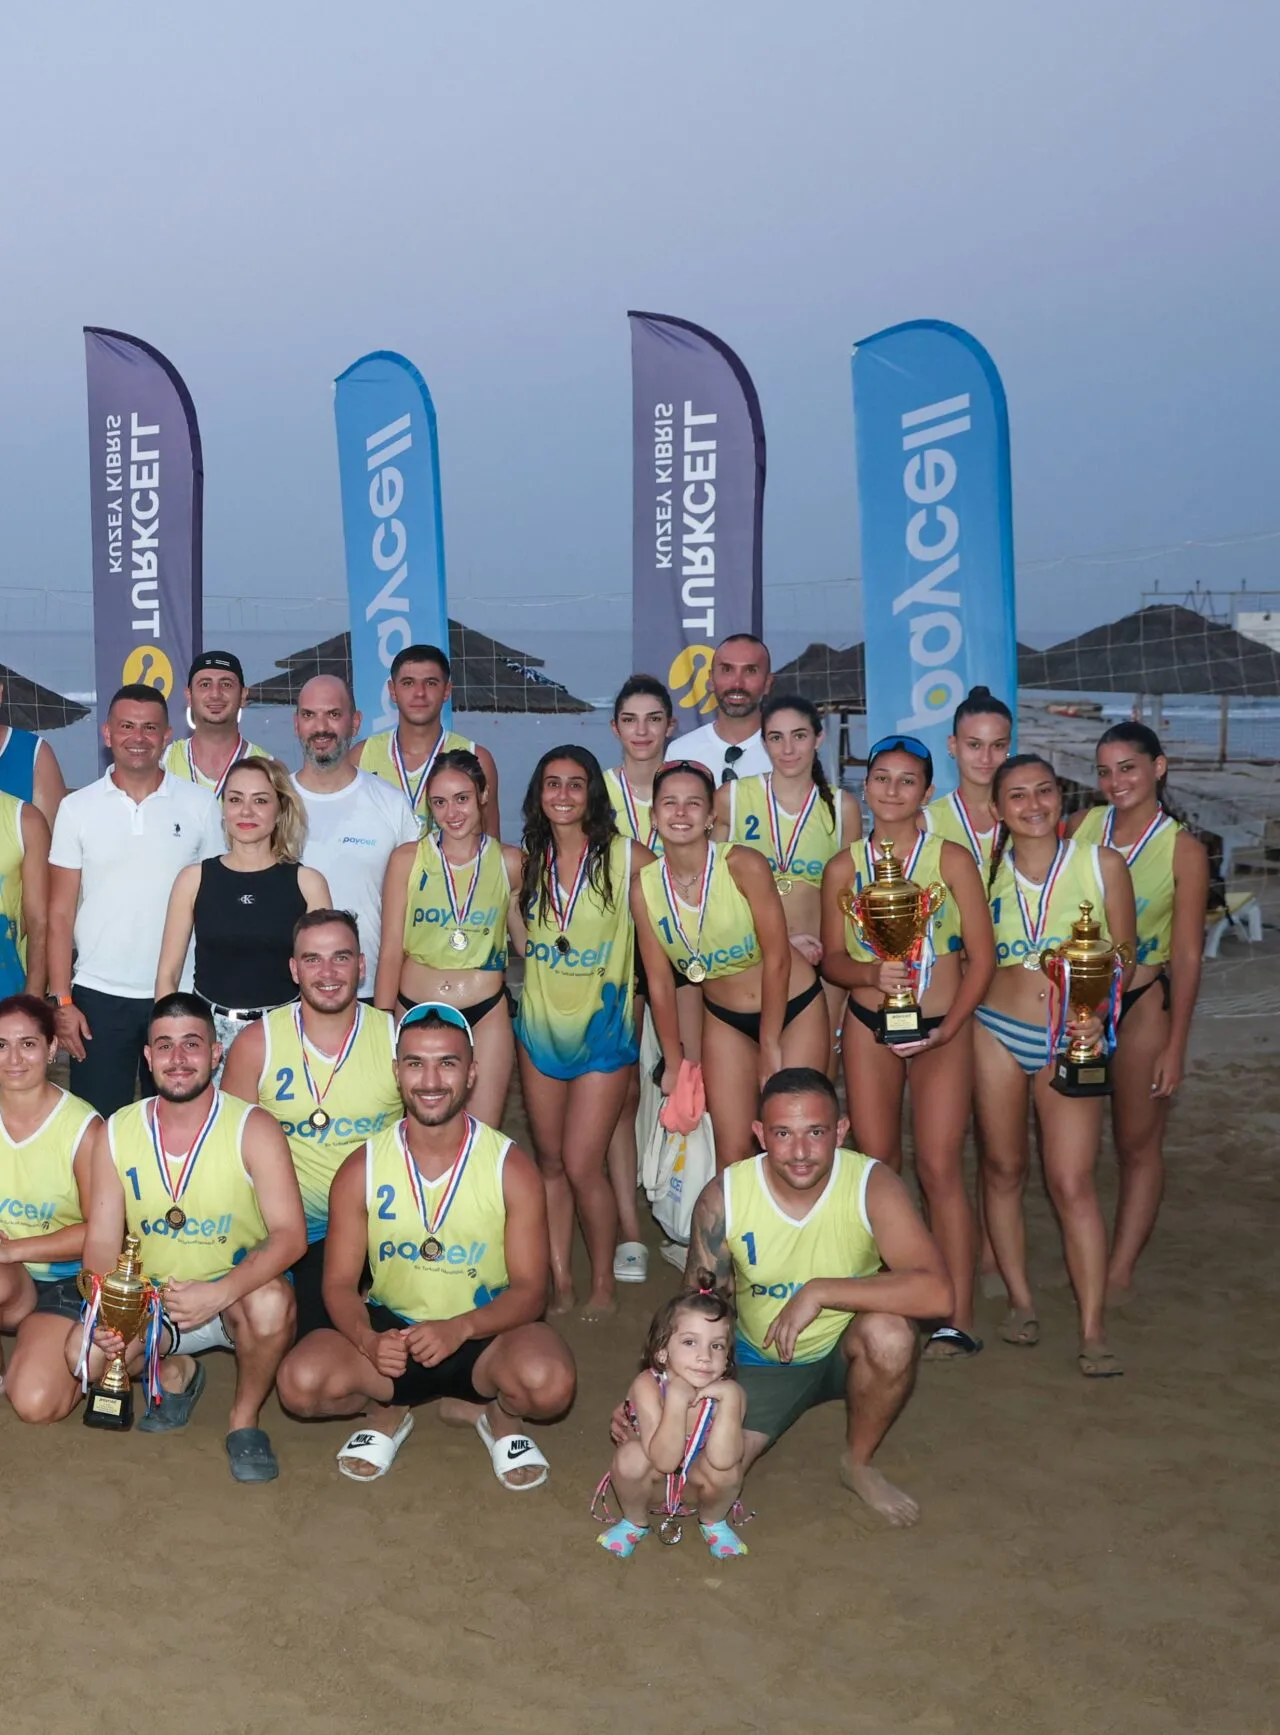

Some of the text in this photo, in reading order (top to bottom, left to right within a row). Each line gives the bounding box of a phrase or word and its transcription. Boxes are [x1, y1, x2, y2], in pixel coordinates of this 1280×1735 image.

[745, 815, 760, 840] 2
[412, 907, 498, 928] payell
[991, 897, 1002, 924] 1
[658, 916, 673, 944] 1
[276, 1067, 295, 1101] 2
[125, 1167, 141, 1200] 1
[376, 1184, 396, 1220] 2
[741, 1232, 757, 1265] 1
[354, 1434, 376, 1445] NIKE
[510, 1440, 530, 1450] NIKE
